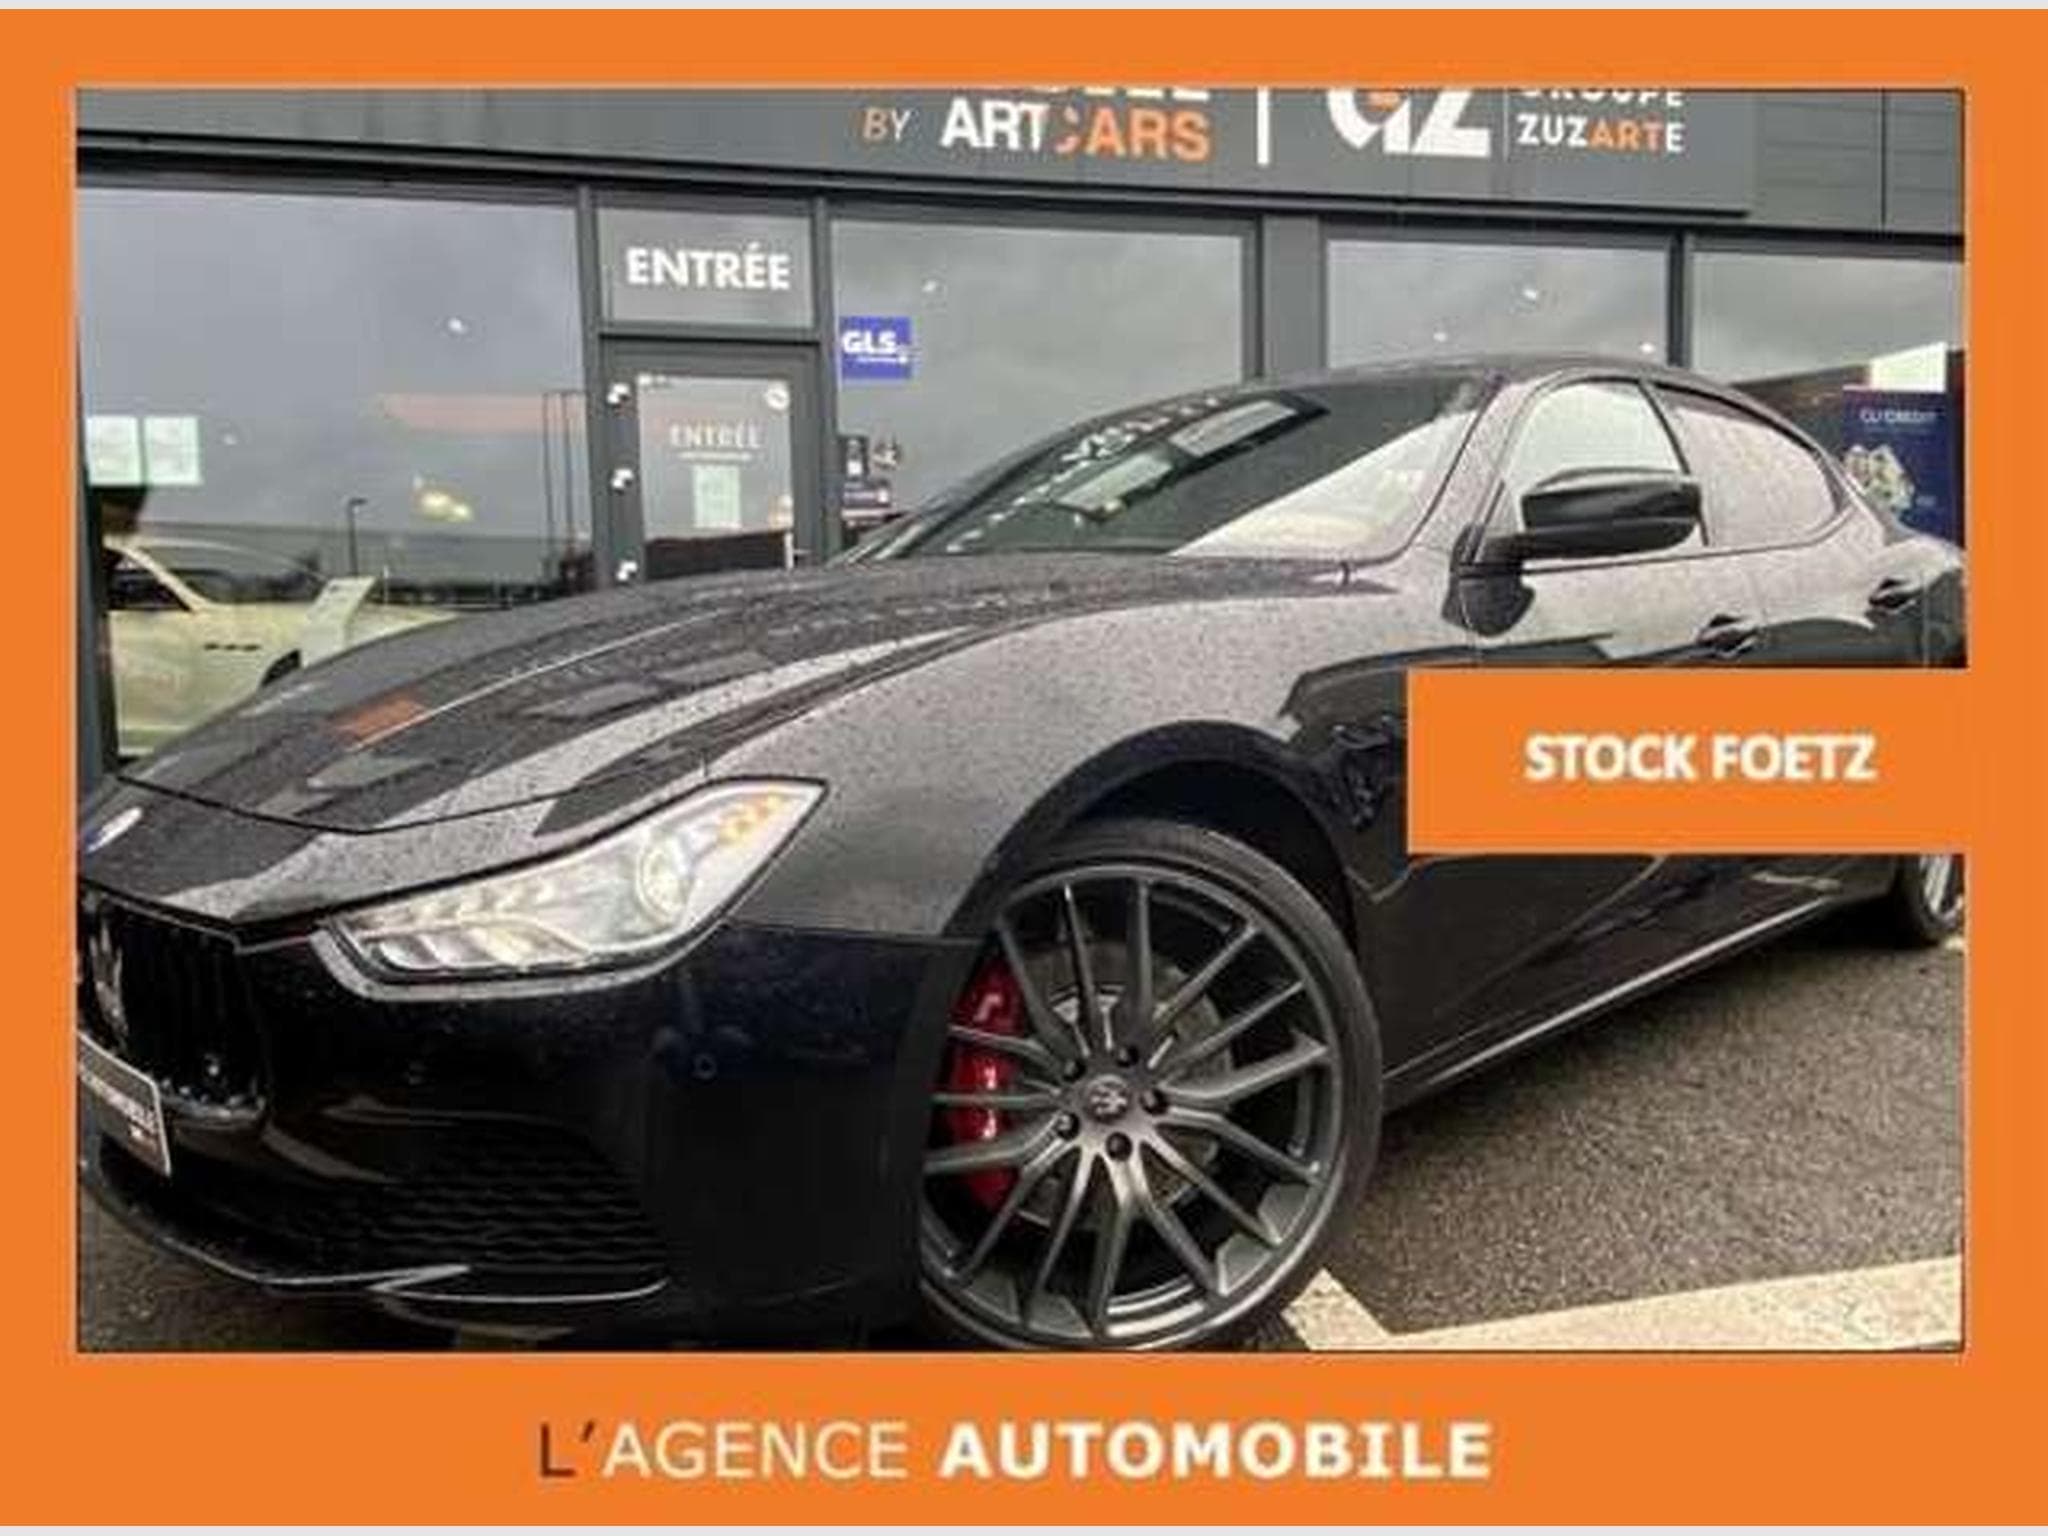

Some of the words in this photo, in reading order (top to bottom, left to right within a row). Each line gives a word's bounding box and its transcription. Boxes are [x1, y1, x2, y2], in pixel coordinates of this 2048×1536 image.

[862, 106, 911, 142] BY
[1516, 112, 1686, 152] ZUZARTE
[625, 243, 791, 291] ENTRÉE
[842, 331, 898, 354] GLS
